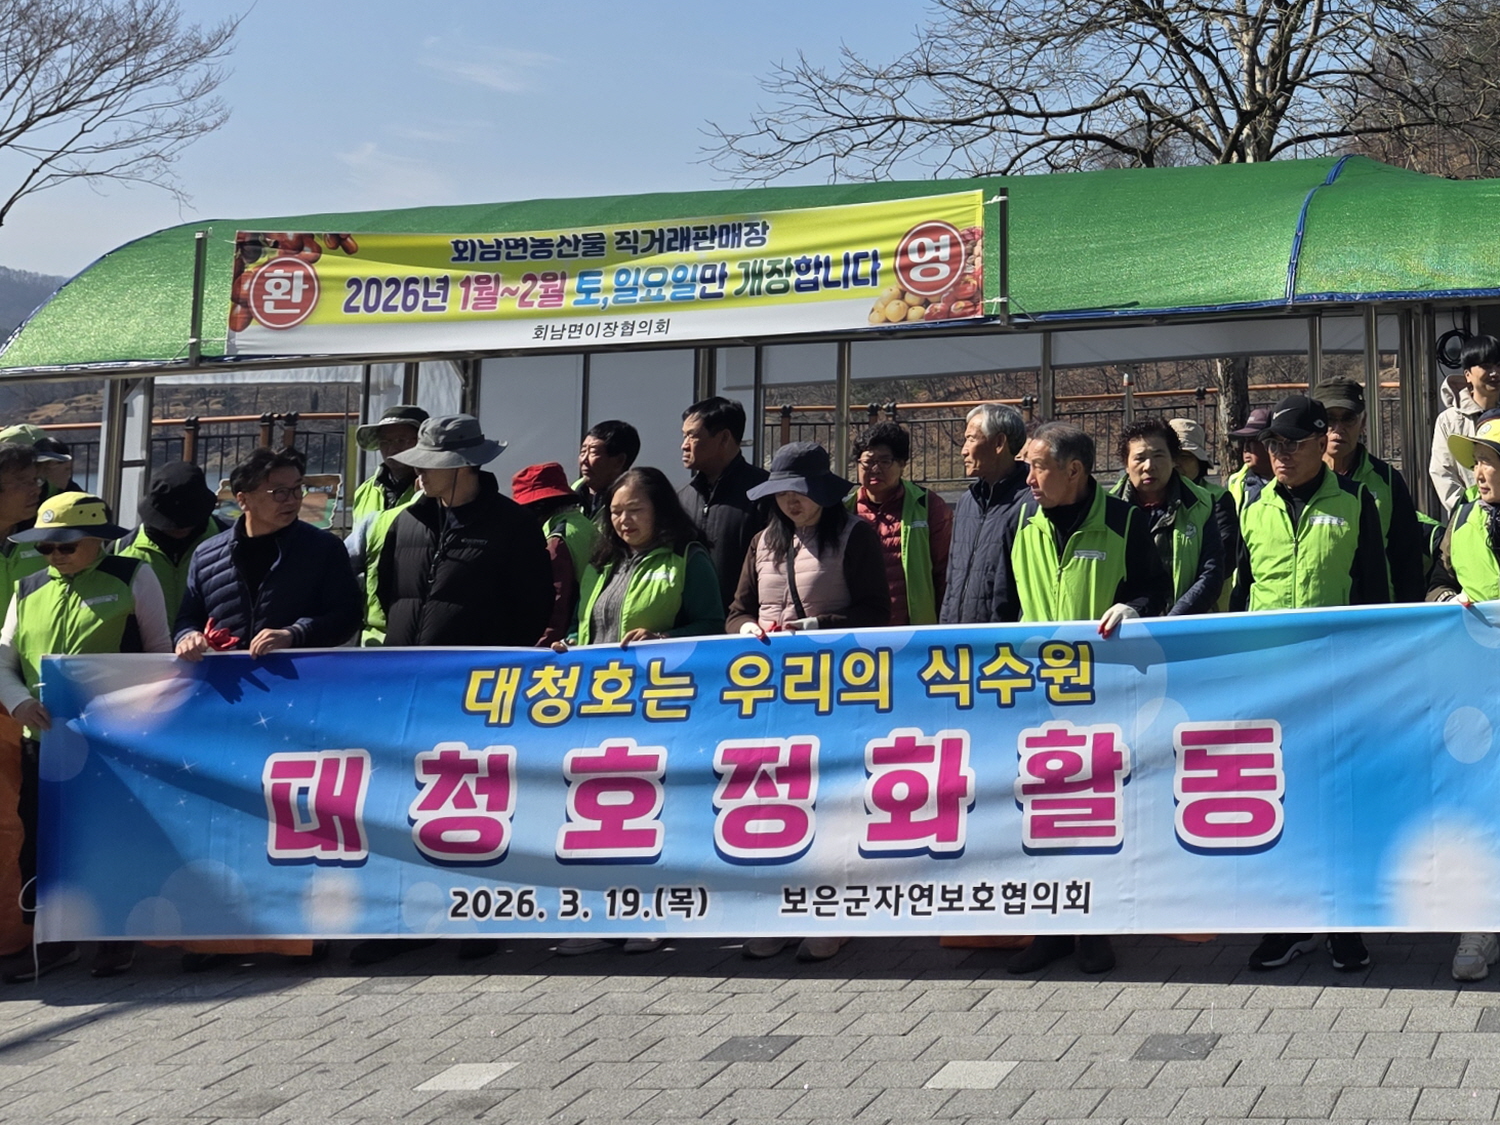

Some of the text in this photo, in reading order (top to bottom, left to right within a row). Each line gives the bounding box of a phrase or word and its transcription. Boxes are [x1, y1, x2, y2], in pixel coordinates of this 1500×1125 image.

[451, 220, 770, 263] 회남면농산물 직거래판매장
[907, 236, 951, 283] 영
[262, 269, 309, 315] 환
[343, 249, 881, 314] 2026년 1월~2월 토,일요일만 개장합니다
[532, 317, 671, 341] 회남면이장협의회
[462, 641, 1096, 725] 대청호는 우리의 식수원
[449, 880, 1091, 920] 2026. 3. 19.(목) 보은군자연보호협의회
